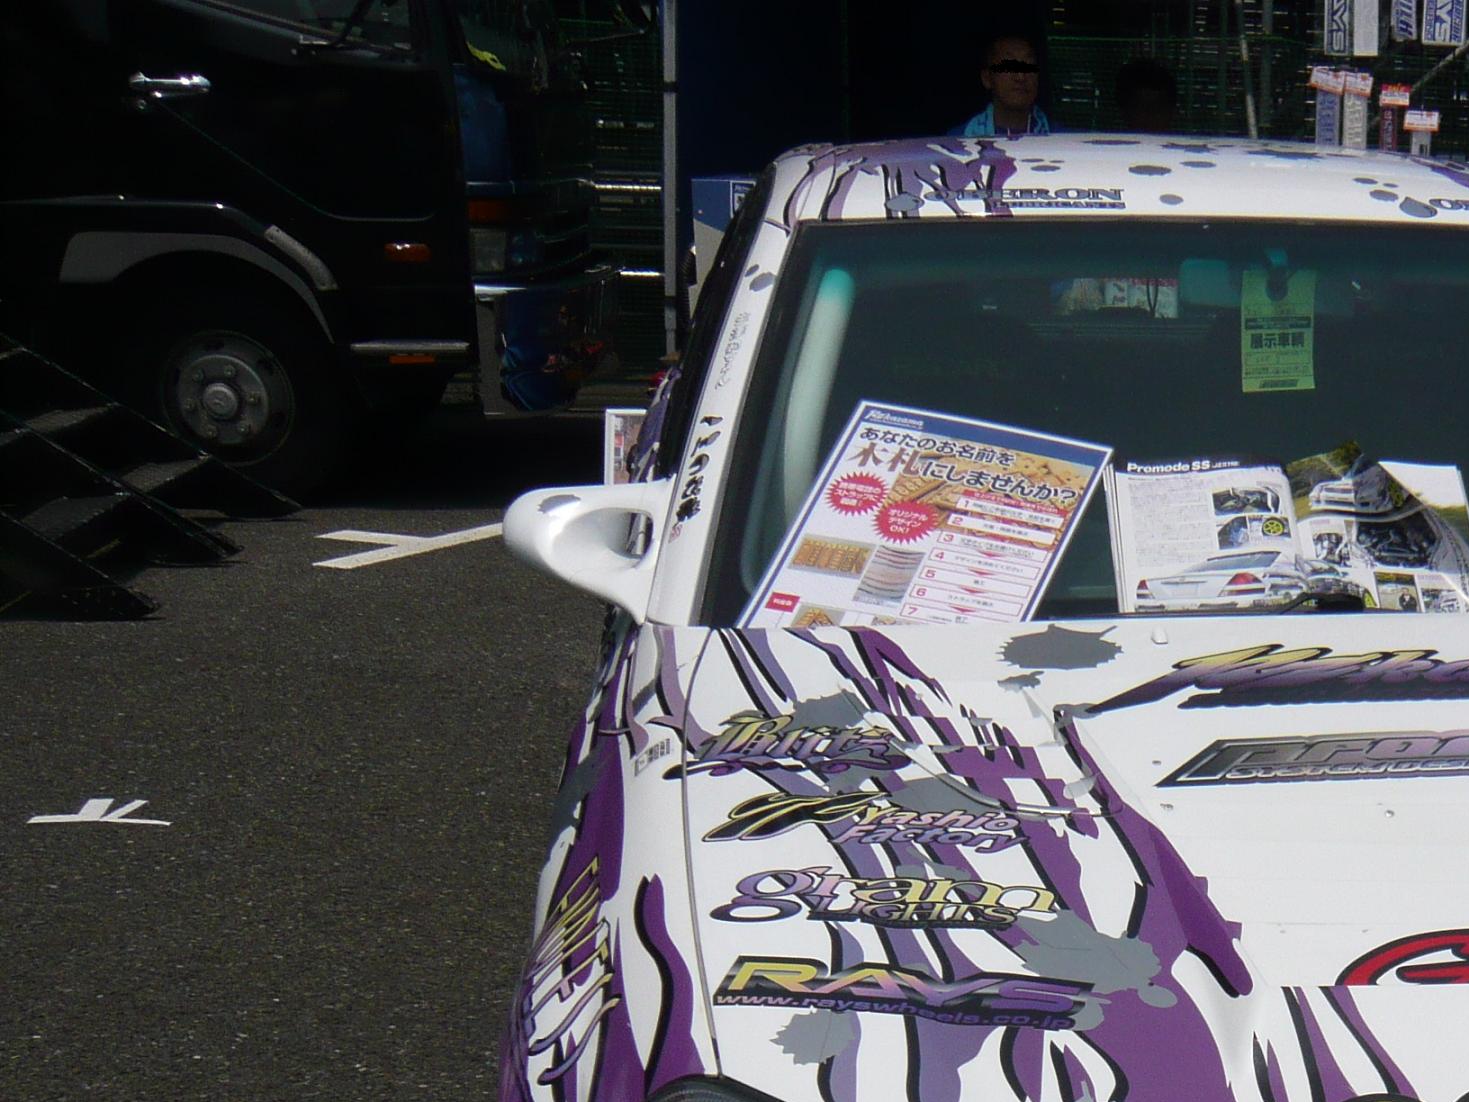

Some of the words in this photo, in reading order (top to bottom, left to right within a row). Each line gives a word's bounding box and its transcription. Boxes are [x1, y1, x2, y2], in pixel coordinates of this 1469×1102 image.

[859, 427, 1016, 468] あなたのお名前を
[1126, 461, 1190, 475] Promode
[1191, 459, 1211, 472] SS
[858, 805, 1022, 833] Yashio
[830, 823, 1030, 853] Factory
[720, 957, 1087, 1016] RAYS
[715, 994, 1073, 1031] www.rayswheels.co.jp
